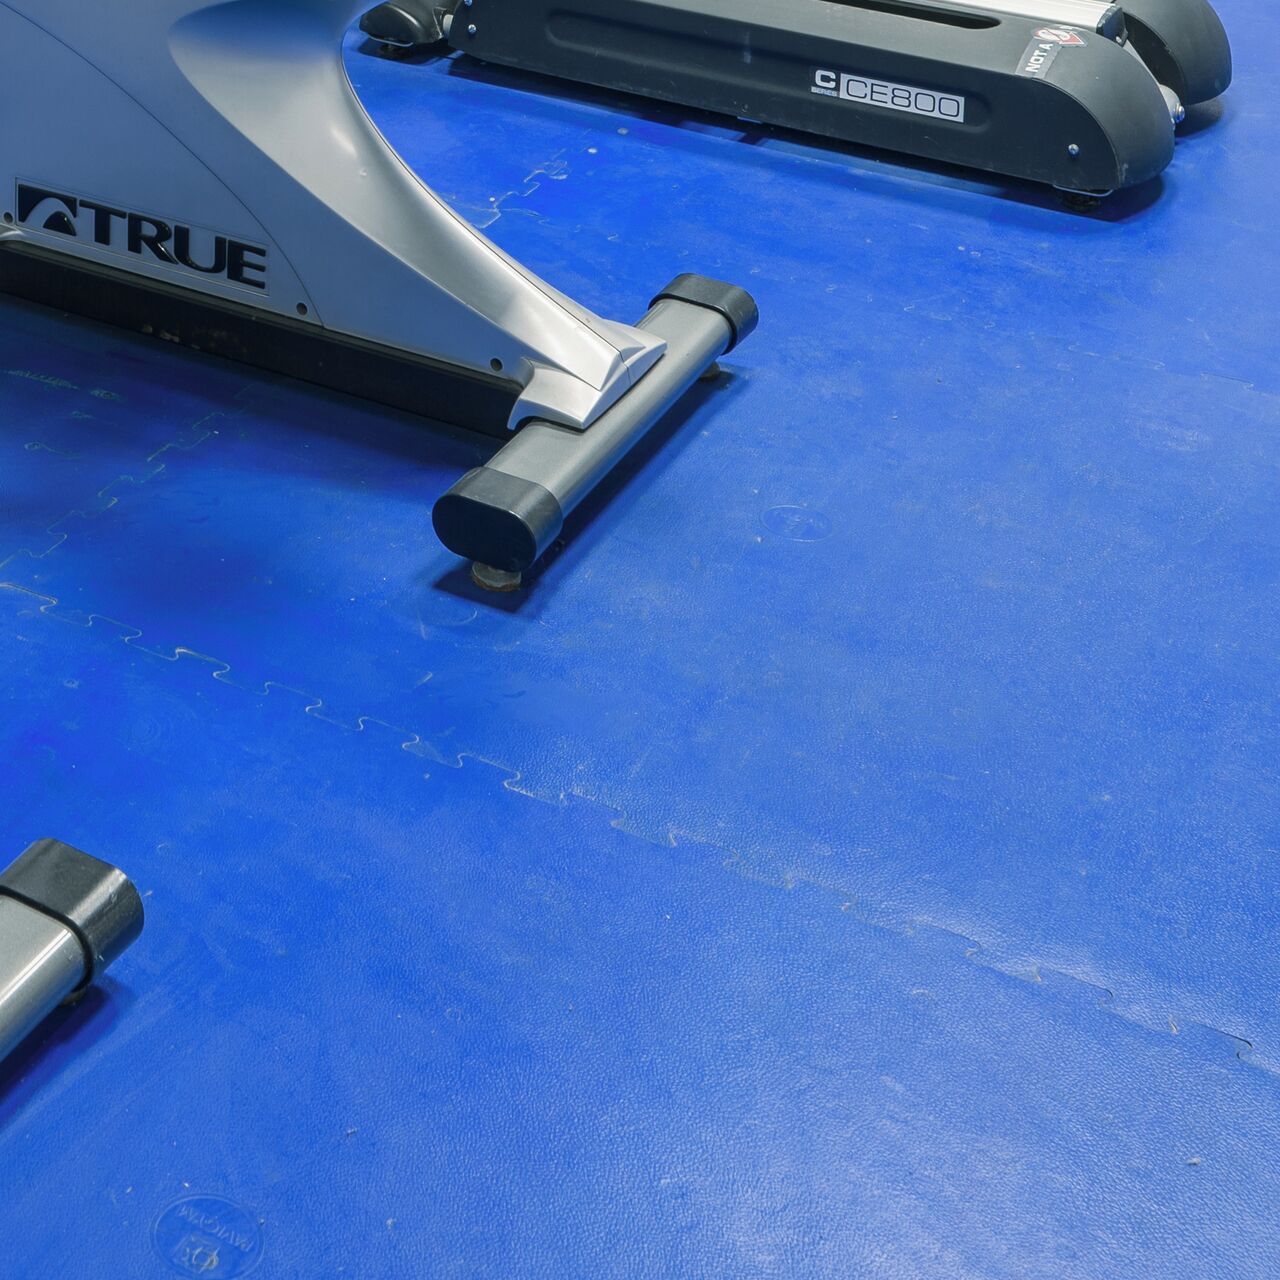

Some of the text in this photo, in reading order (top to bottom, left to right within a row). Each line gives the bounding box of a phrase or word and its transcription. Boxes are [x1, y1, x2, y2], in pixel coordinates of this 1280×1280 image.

[1025, 49, 1048, 73] NOT
[815, 69, 960, 118] C CE800
[78, 198, 267, 290] TRUE
